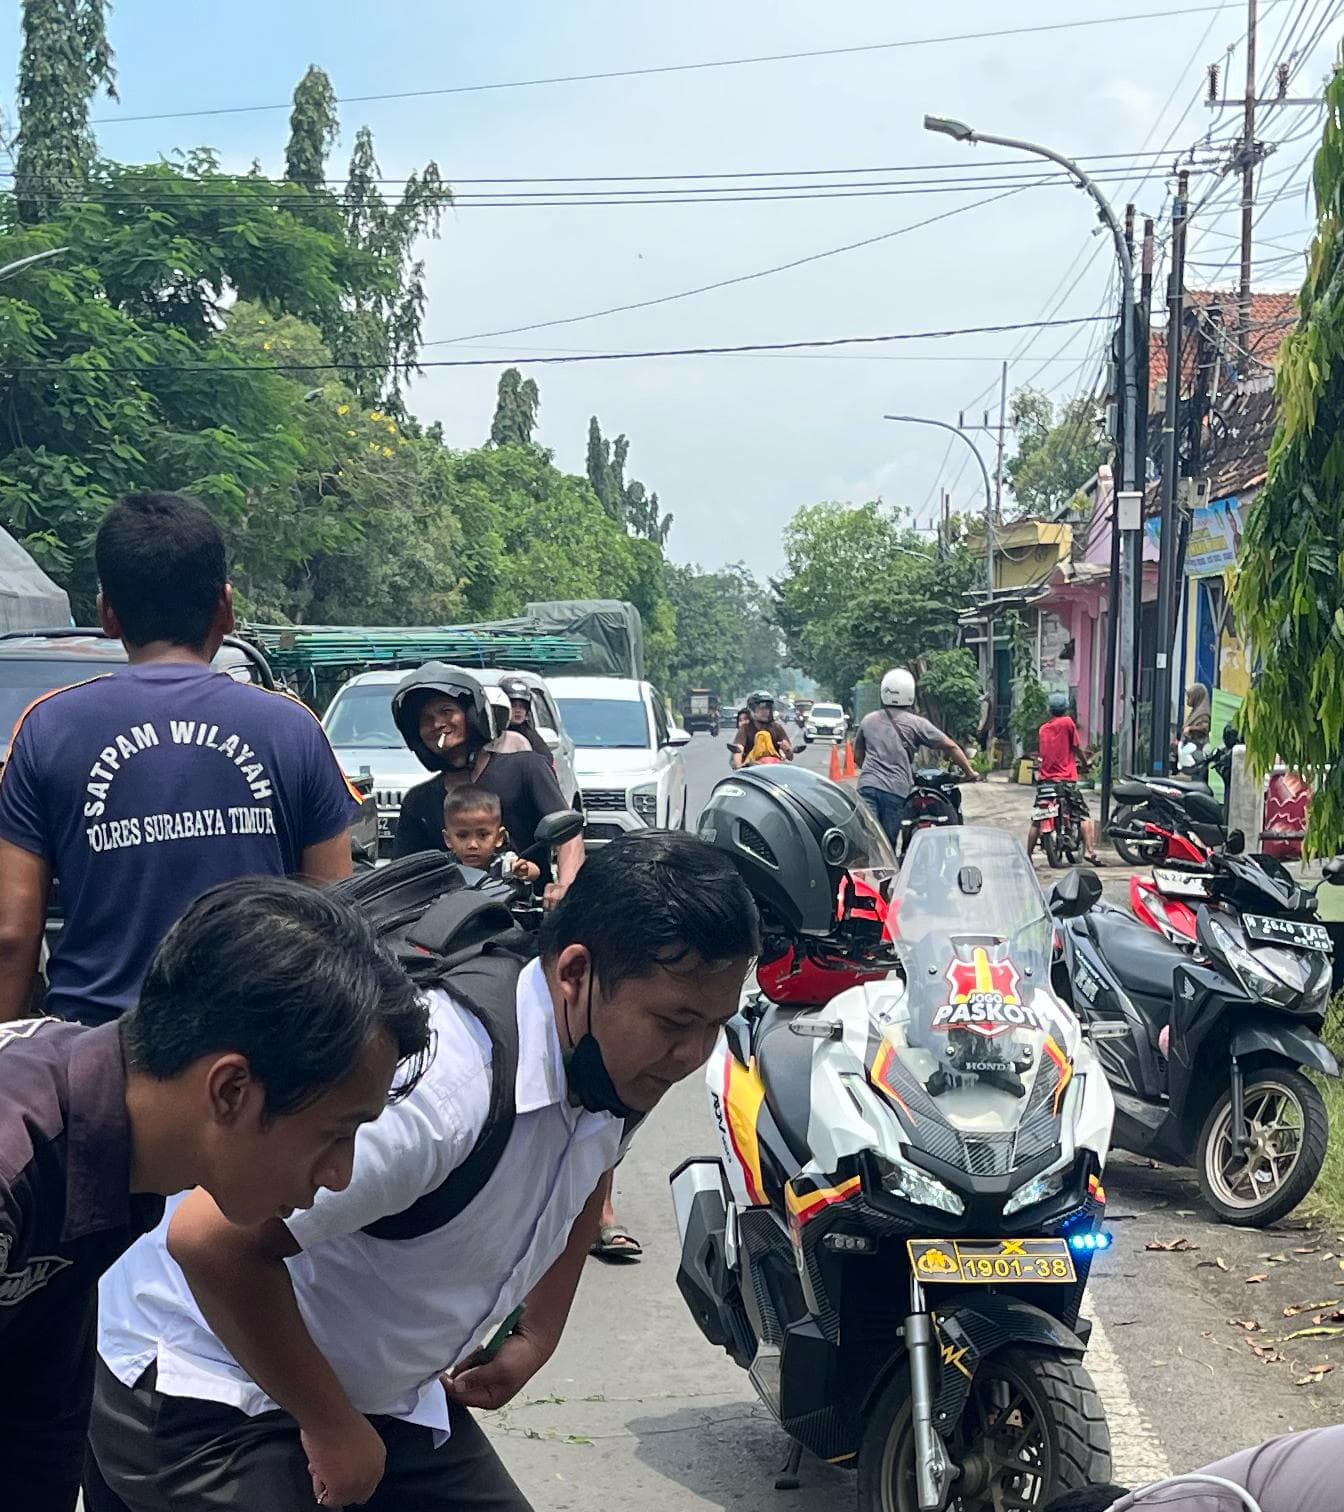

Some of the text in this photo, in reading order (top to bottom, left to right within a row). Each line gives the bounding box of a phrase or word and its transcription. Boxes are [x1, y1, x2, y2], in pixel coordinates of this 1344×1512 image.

[84, 720, 274, 818] SATPAM WILAYAH
[143, 808, 226, 843] SURABAYA
[228, 807, 277, 835] TIMUR
[969, 993, 1003, 1004] JOGO
[932, 1003, 1038, 1026] PASKOT
[965, 1061, 1015, 1072] HOND
[965, 1258, 1067, 1277] 1901-38
